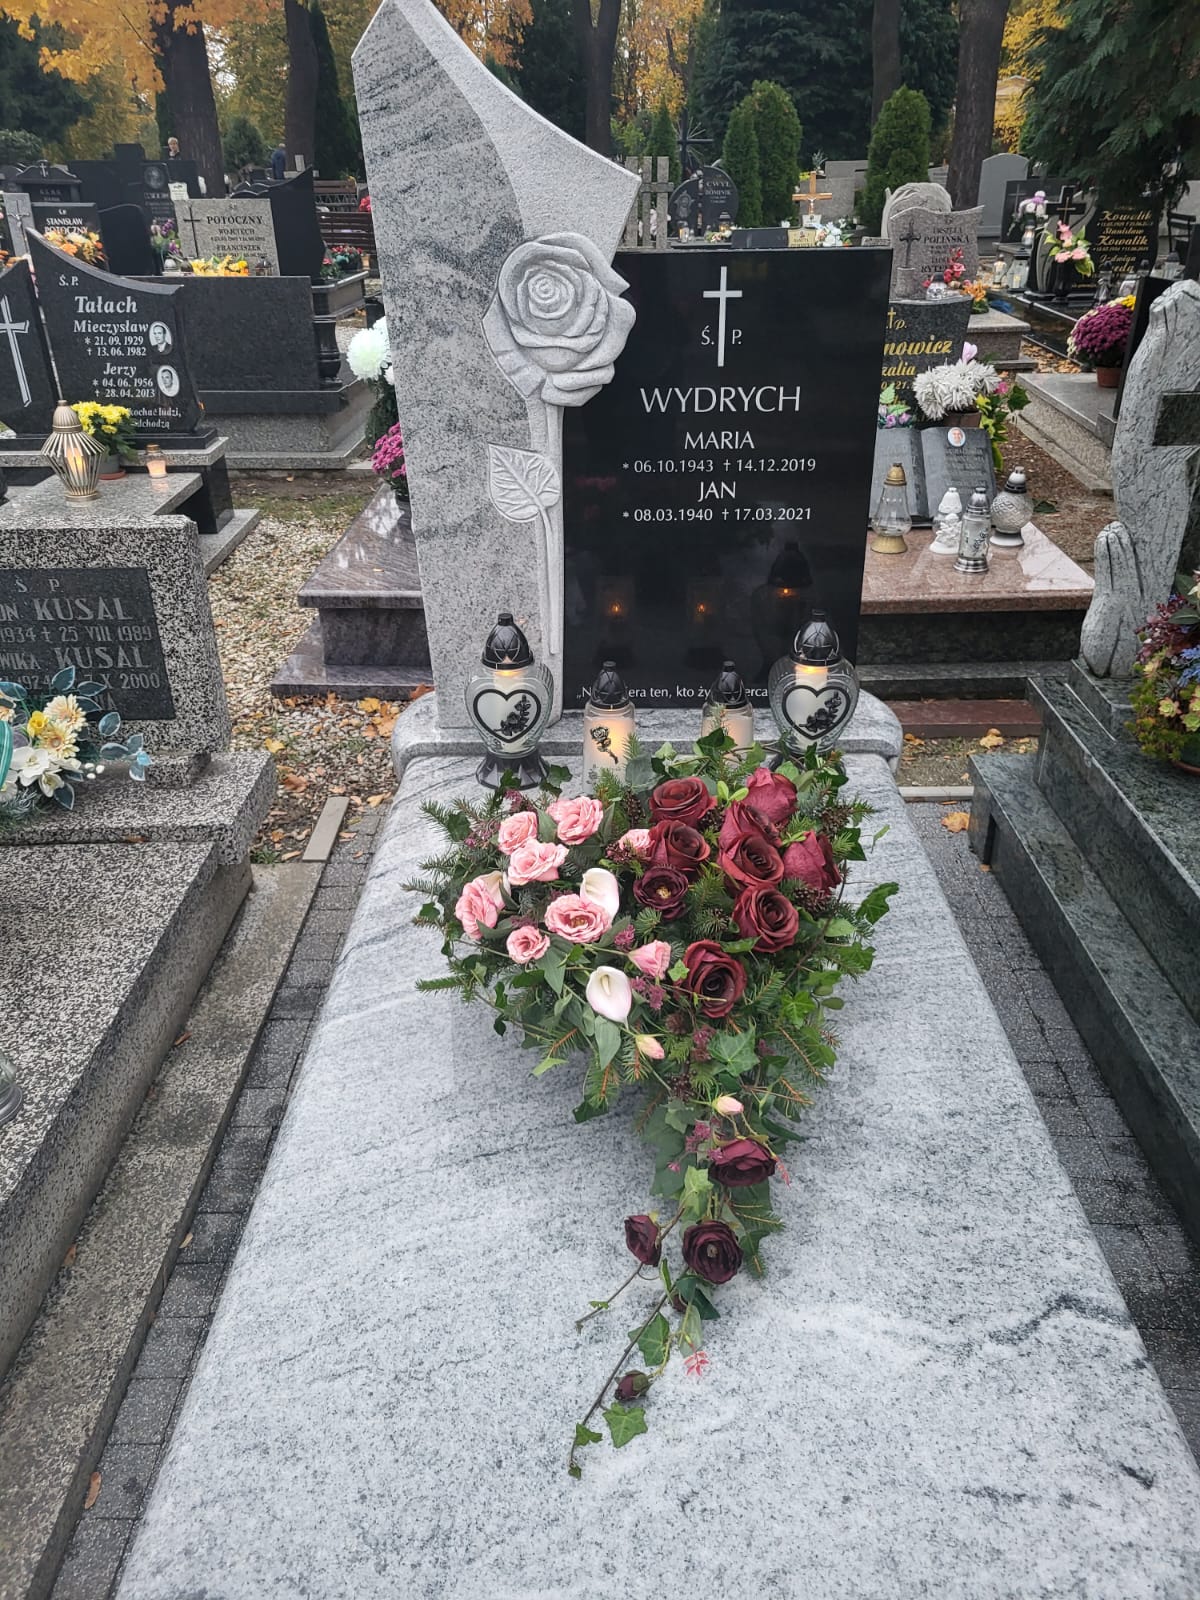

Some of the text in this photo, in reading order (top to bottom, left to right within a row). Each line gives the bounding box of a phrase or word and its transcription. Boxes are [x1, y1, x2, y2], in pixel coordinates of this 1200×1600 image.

[206, 215, 263, 225] POTOCZNY
[1097, 235, 1149, 246] Kowalik
[74, 295, 138, 313] Tałach
[73, 319, 149, 335] Mieczysław
[701, 325, 742, 345] Ś. P.
[883, 334, 953, 356] nowicz
[103, 362, 137, 378] Jerzy
[881, 360, 917, 377] zalia
[640, 385, 801, 413] WYDRYCH
[684, 431, 755, 450] MARIA
[633, 458, 817, 473] 06.10.1943 14.12.2019
[697, 481, 737, 502] JAN
[633, 507, 812, 522] 08.03.1940 17.03.2021
[32, 596, 134, 621] KUSAL
[58, 626, 79, 642] 25
[84, 625, 113, 642] VIII
[0, 645, 151, 670] WIKA KUSAL
[119, 673, 160, 690] 2000
[650, 686, 672, 699] ten,
[676, 684, 695, 698] kto
[697, 685, 712, 701] ży
[744, 688, 769, 698] erca
